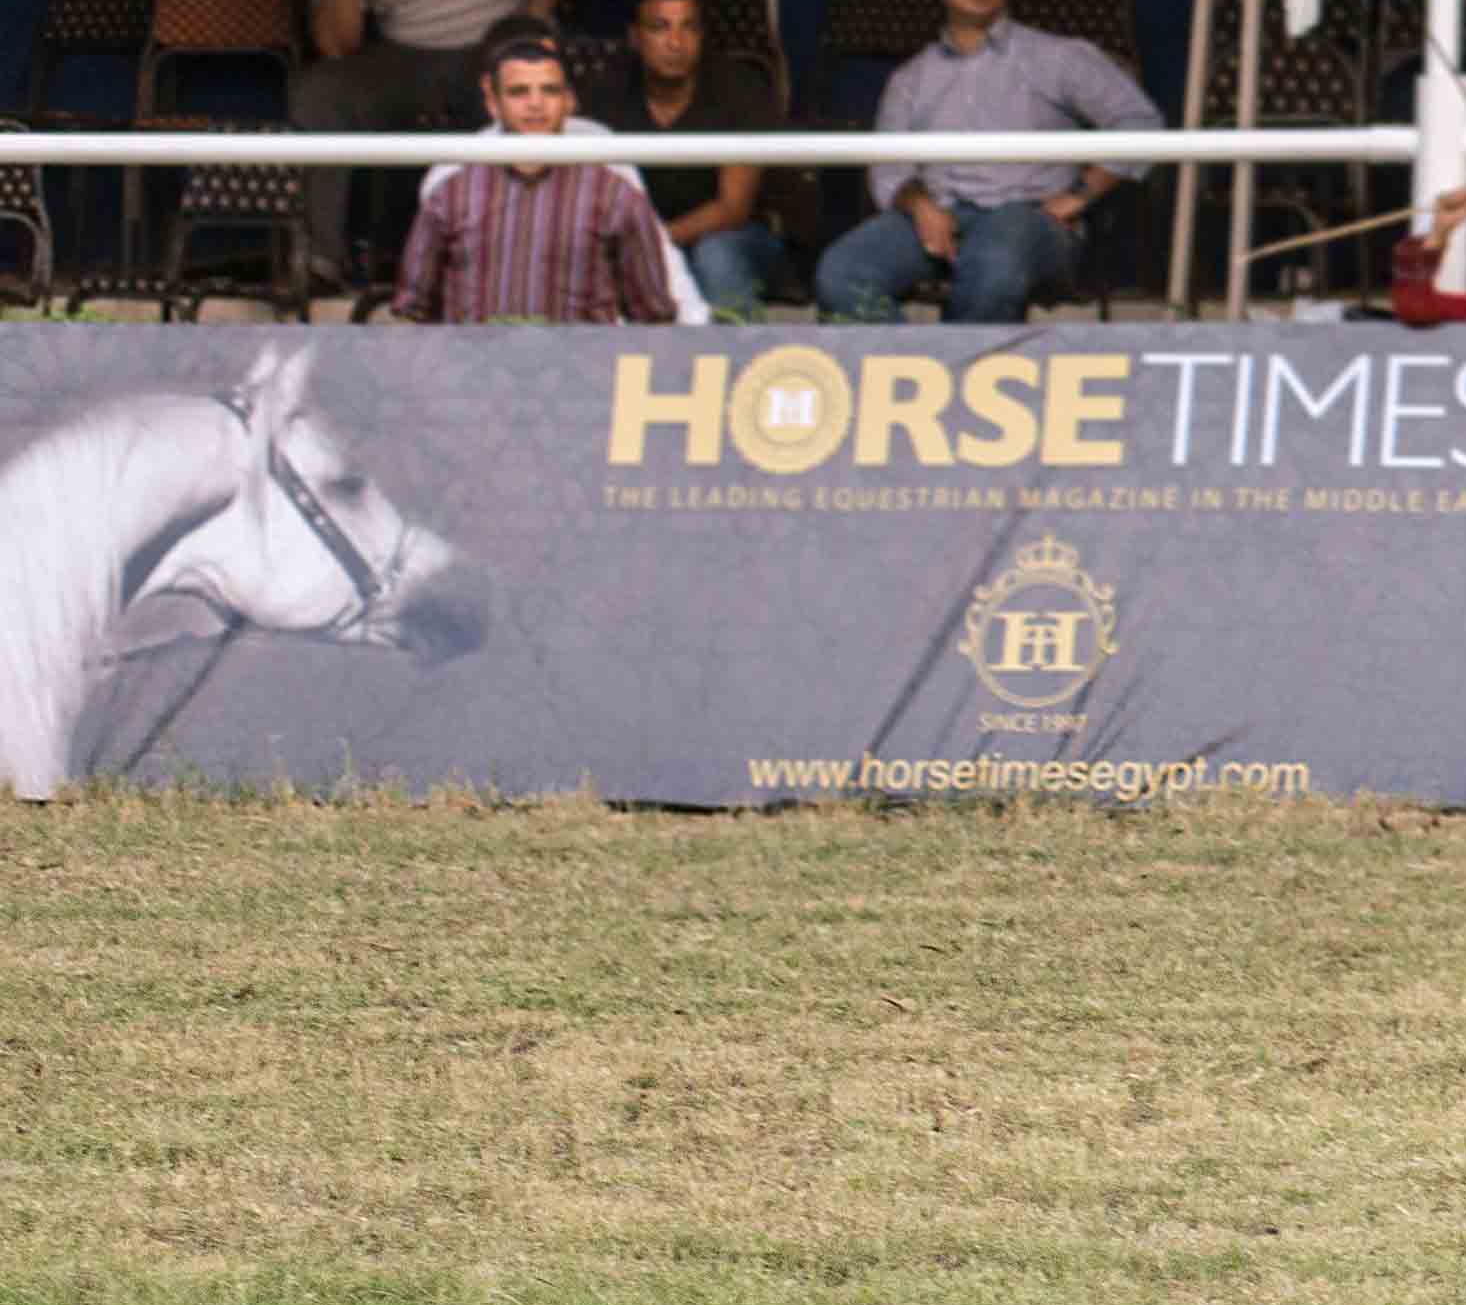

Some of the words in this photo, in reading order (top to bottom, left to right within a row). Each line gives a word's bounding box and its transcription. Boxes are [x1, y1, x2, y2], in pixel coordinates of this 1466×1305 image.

[608, 345, 1129, 474] HORSE
[606, 485, 658, 512] THE
[669, 485, 803, 512] LEADING
[815, 485, 1007, 512] EQUESTRIAN
[1017, 485, 1179, 513] MAGAZINE
[1191, 485, 1224, 513] IN
[1232, 486, 1291, 513] THE
[1302, 487, 1425, 514] MIDDLE
[747, 750, 1311, 800] www.horsetimesegypt.com
